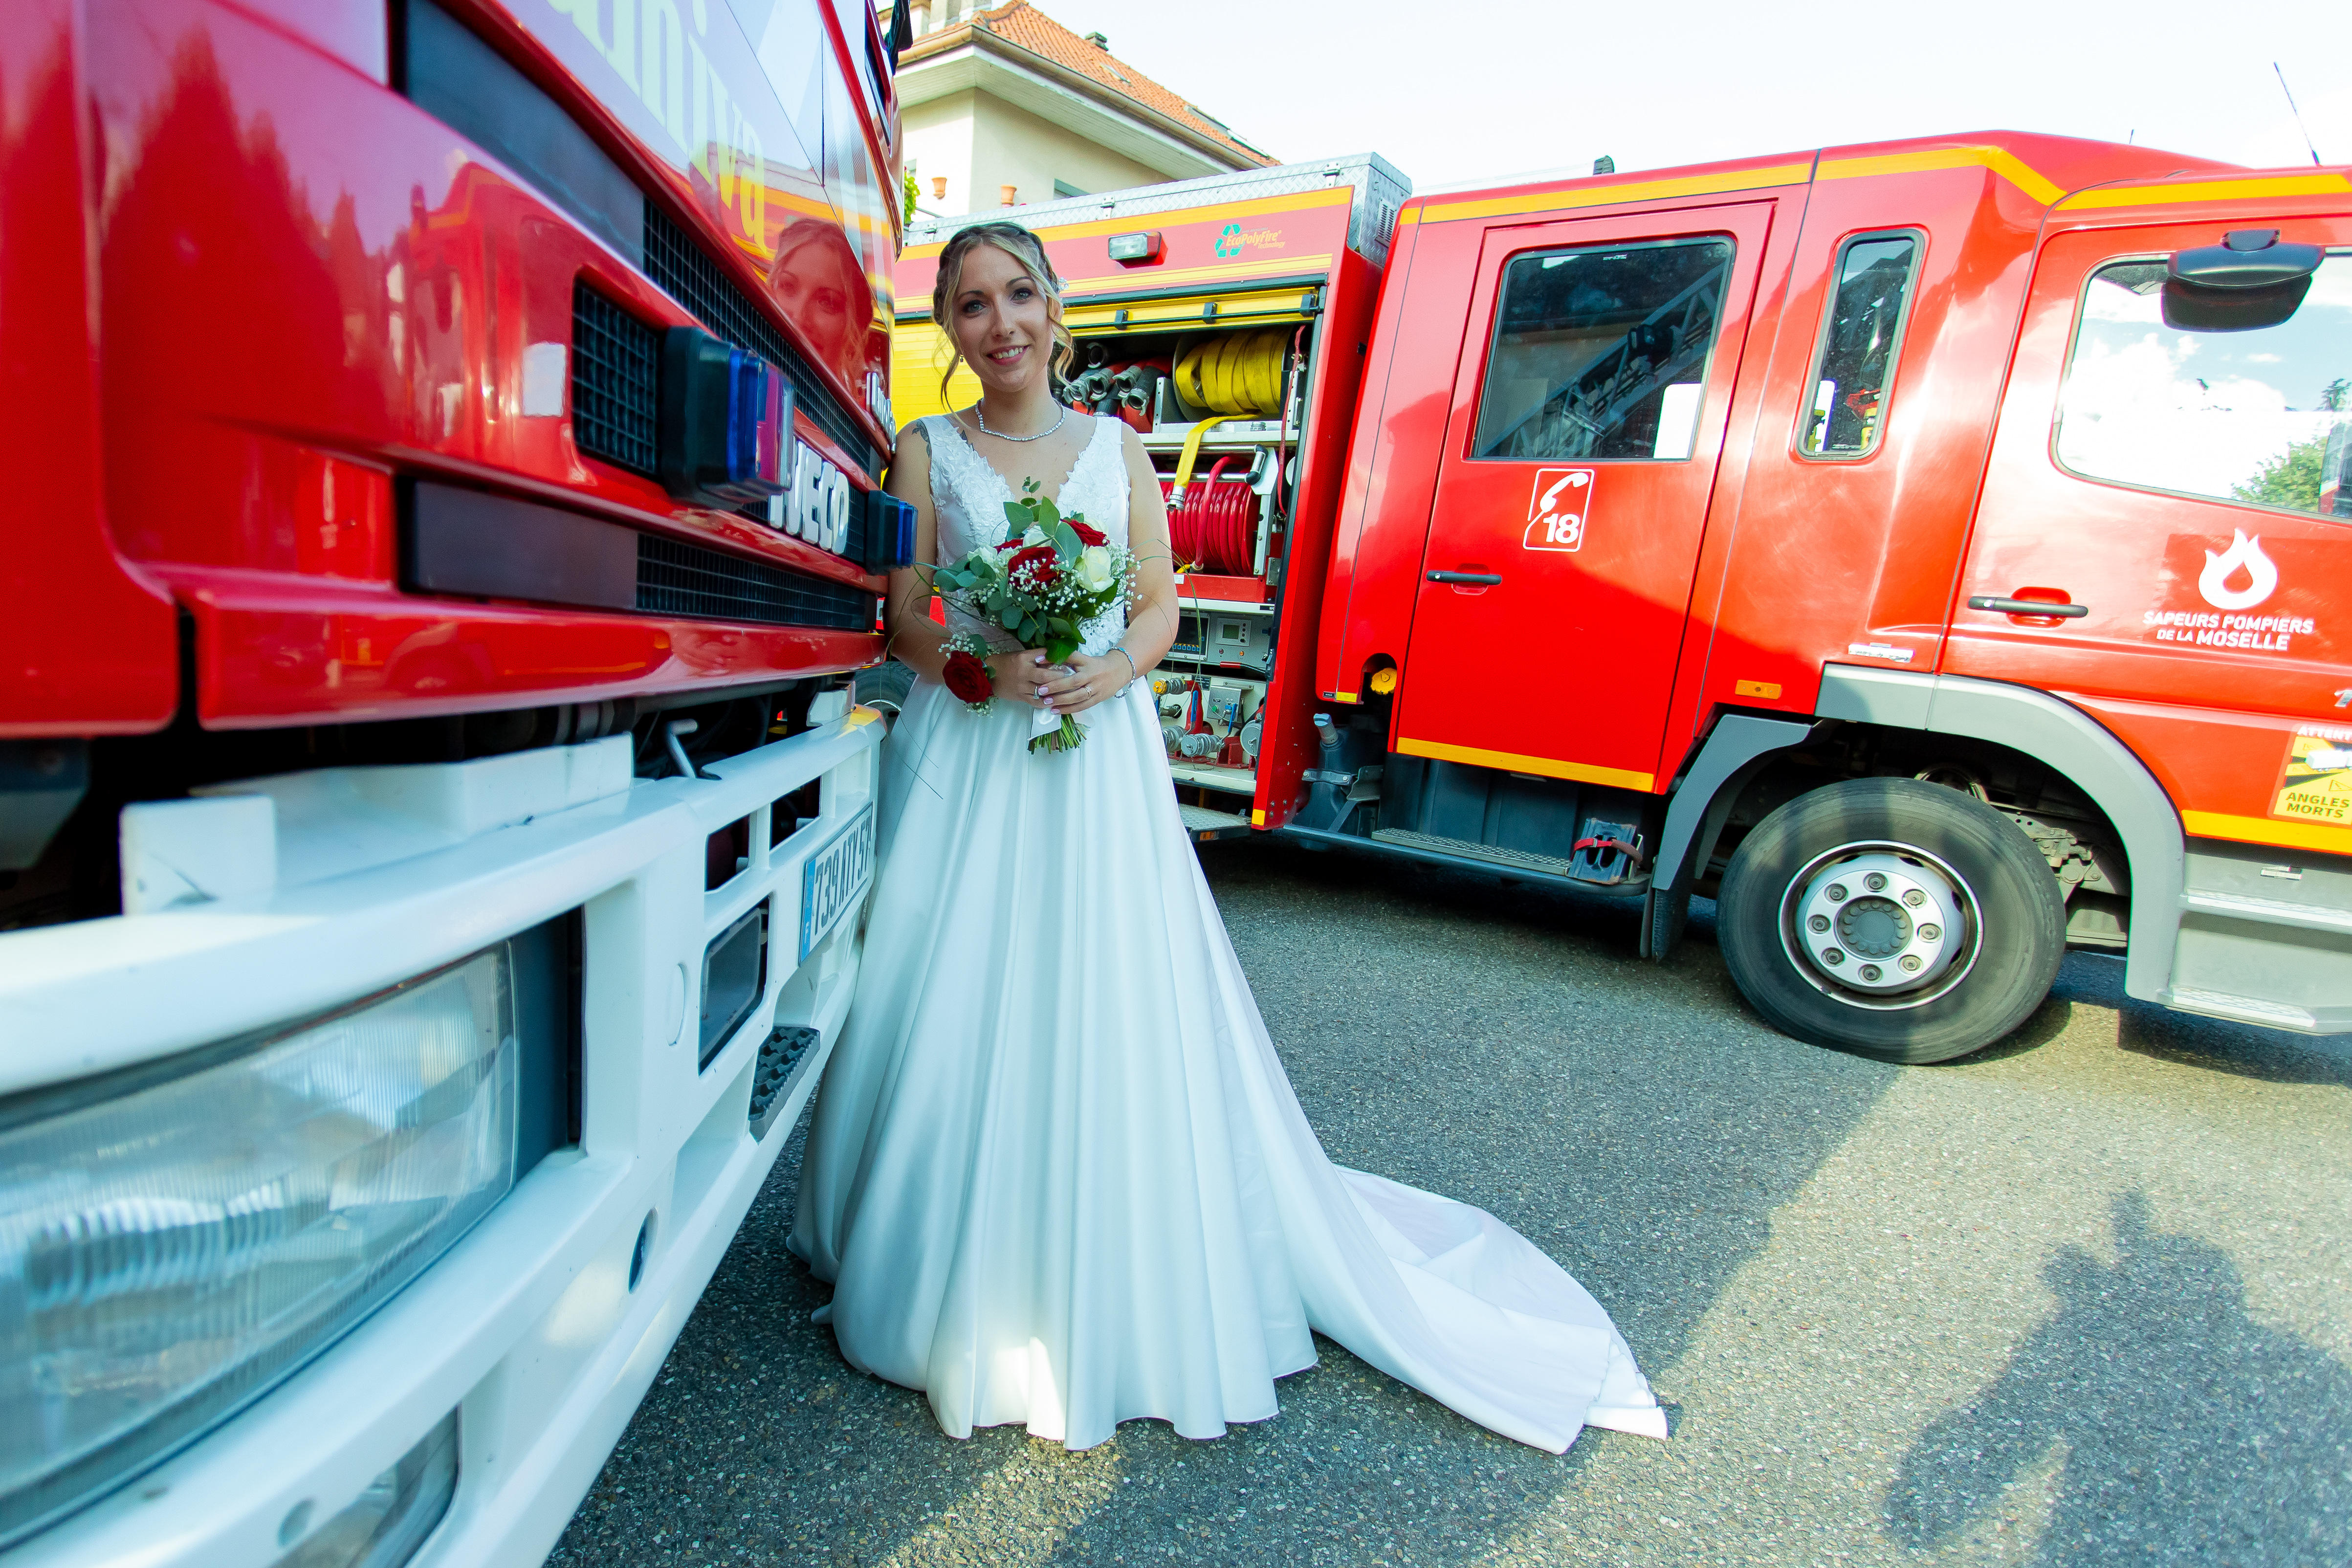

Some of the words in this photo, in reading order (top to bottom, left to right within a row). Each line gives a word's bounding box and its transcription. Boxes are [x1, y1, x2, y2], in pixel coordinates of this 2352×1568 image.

[1543, 512, 1581, 544] 18
[2142, 611, 2220, 629] SAPEURS
[2222, 615, 2315, 634] POMPIERS
[2156, 629, 2176, 640] DE
[2176, 630, 2194, 642] LA
[2196, 630, 2290, 651] MOSELLE
[2286, 792, 2350, 808] ANGLES
[2286, 803, 2344, 818] MORTS
